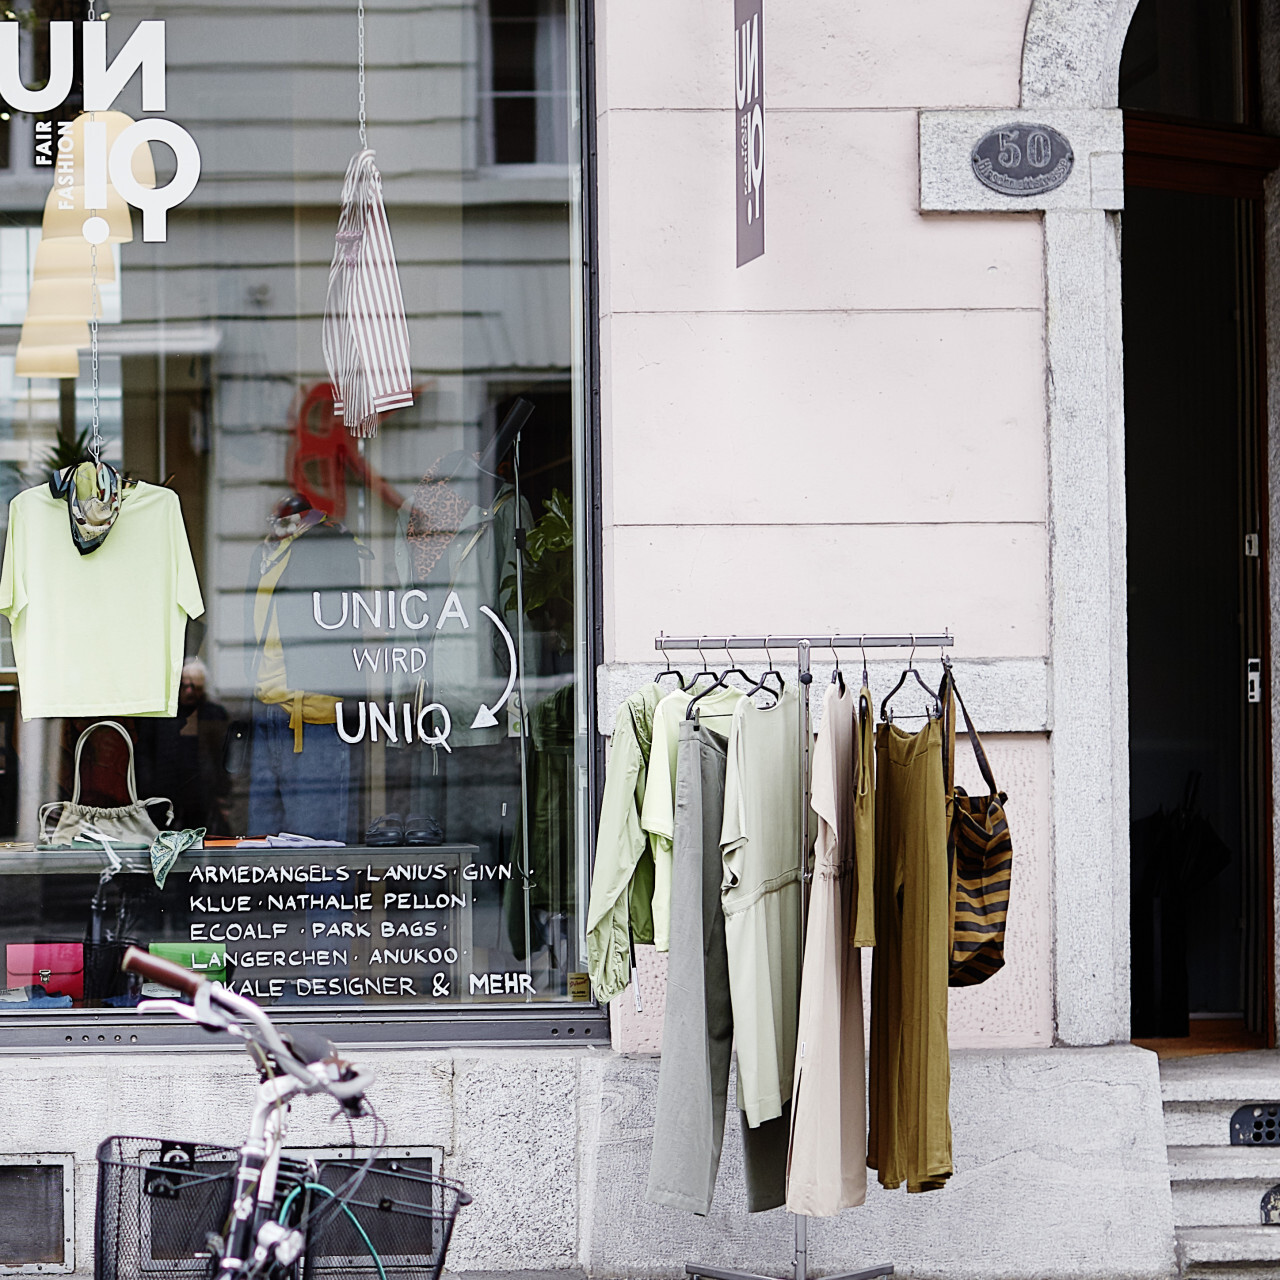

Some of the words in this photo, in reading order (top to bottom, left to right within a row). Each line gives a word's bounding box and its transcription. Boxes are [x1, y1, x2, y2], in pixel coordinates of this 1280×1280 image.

[35, 120, 52, 166] FAIR
[998, 130, 1051, 169] 50
[57, 121, 74, 210] FASHION
[312, 589, 470, 630] UNICA
[352, 647, 427, 674] WIRD
[335, 701, 453, 754] UNIQ
[189, 864, 350, 884] ARMEDANGELS
[366, 863, 448, 882] LANIUS
[189, 895, 252, 913] KLUE
[267, 892, 373, 911] NATHALIE
[384, 892, 467, 910] PELLON
[189, 922, 288, 942] ECOALF
[312, 921, 372, 939] PARK
[380, 921, 438, 938] BAGS
[190, 949, 348, 970] LANGERCHEN
[368, 947, 459, 966] ANUKOO
[214, 978, 286, 998] KALE
[296, 976, 417, 997] DESIGNER
[431, 972, 451, 998] &
[469, 971, 537, 996] MEHR
